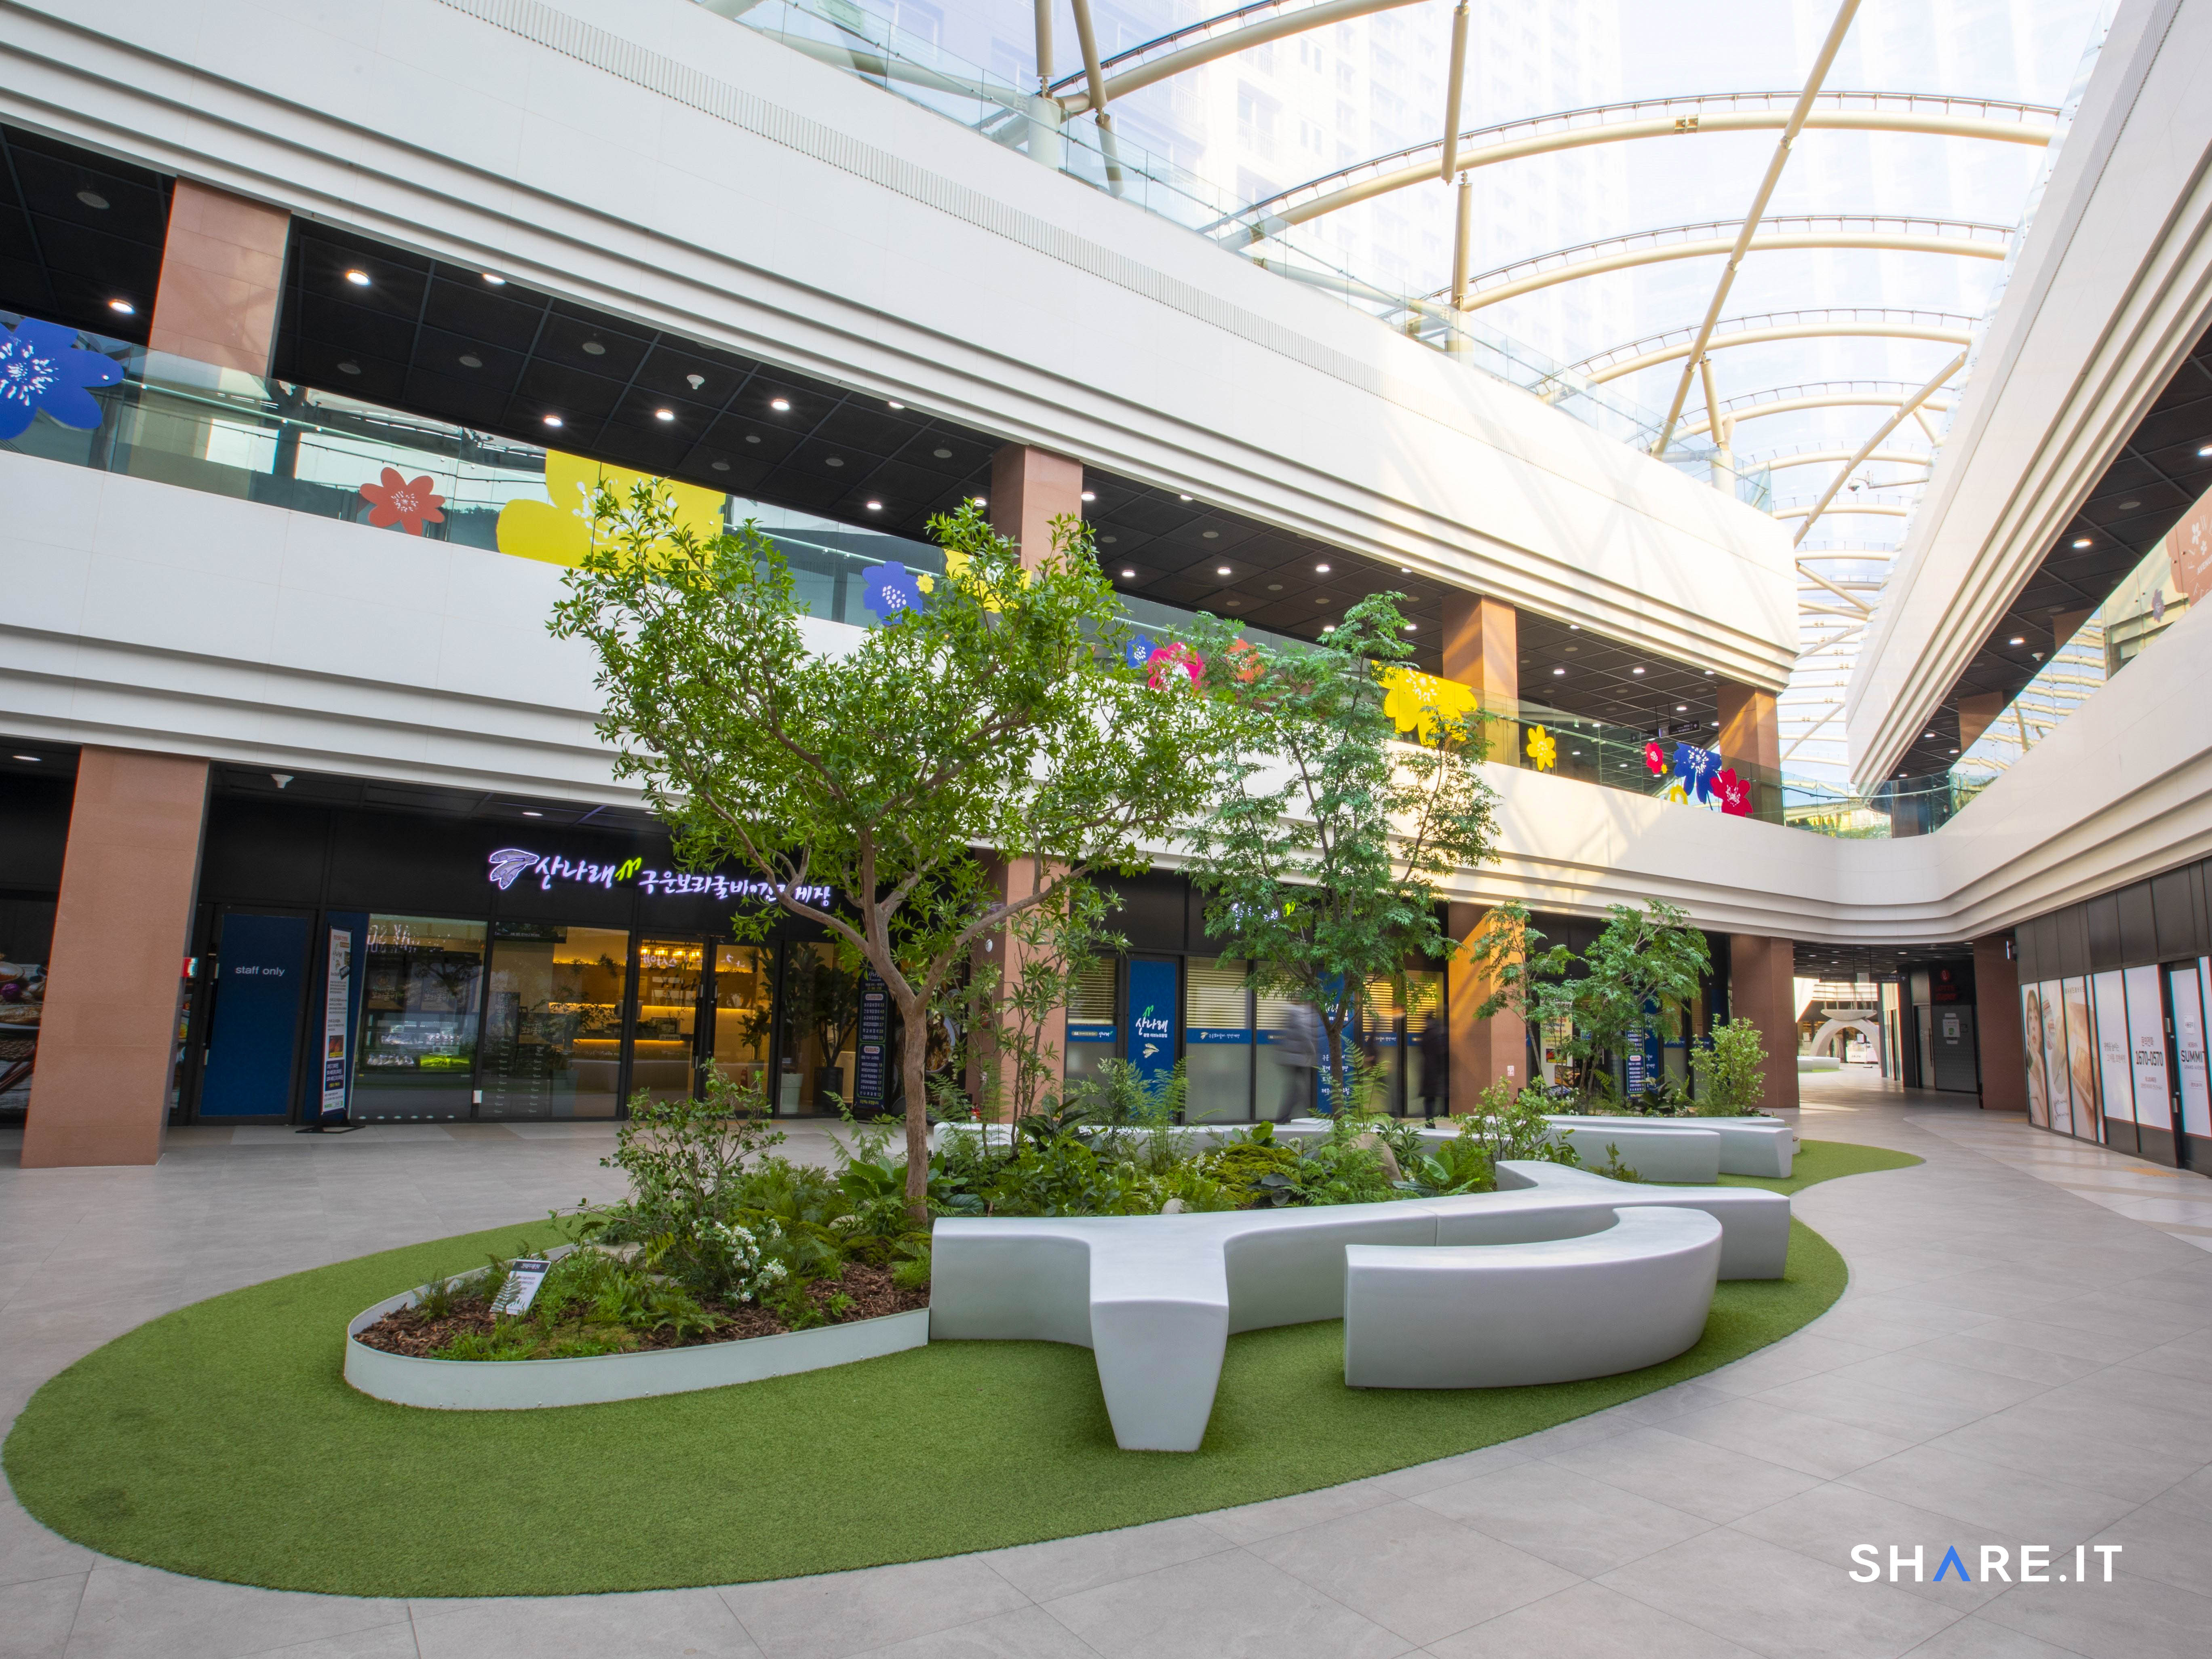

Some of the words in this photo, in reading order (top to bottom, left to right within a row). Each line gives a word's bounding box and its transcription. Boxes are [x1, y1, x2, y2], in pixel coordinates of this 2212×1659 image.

[534, 856, 616, 890] 산나래
[236, 966, 259, 974] staff
[263, 967, 285, 976] only
[1135, 1017, 1168, 1035] 산나래
[2136, 1050, 2163, 1067] 1670-0570
